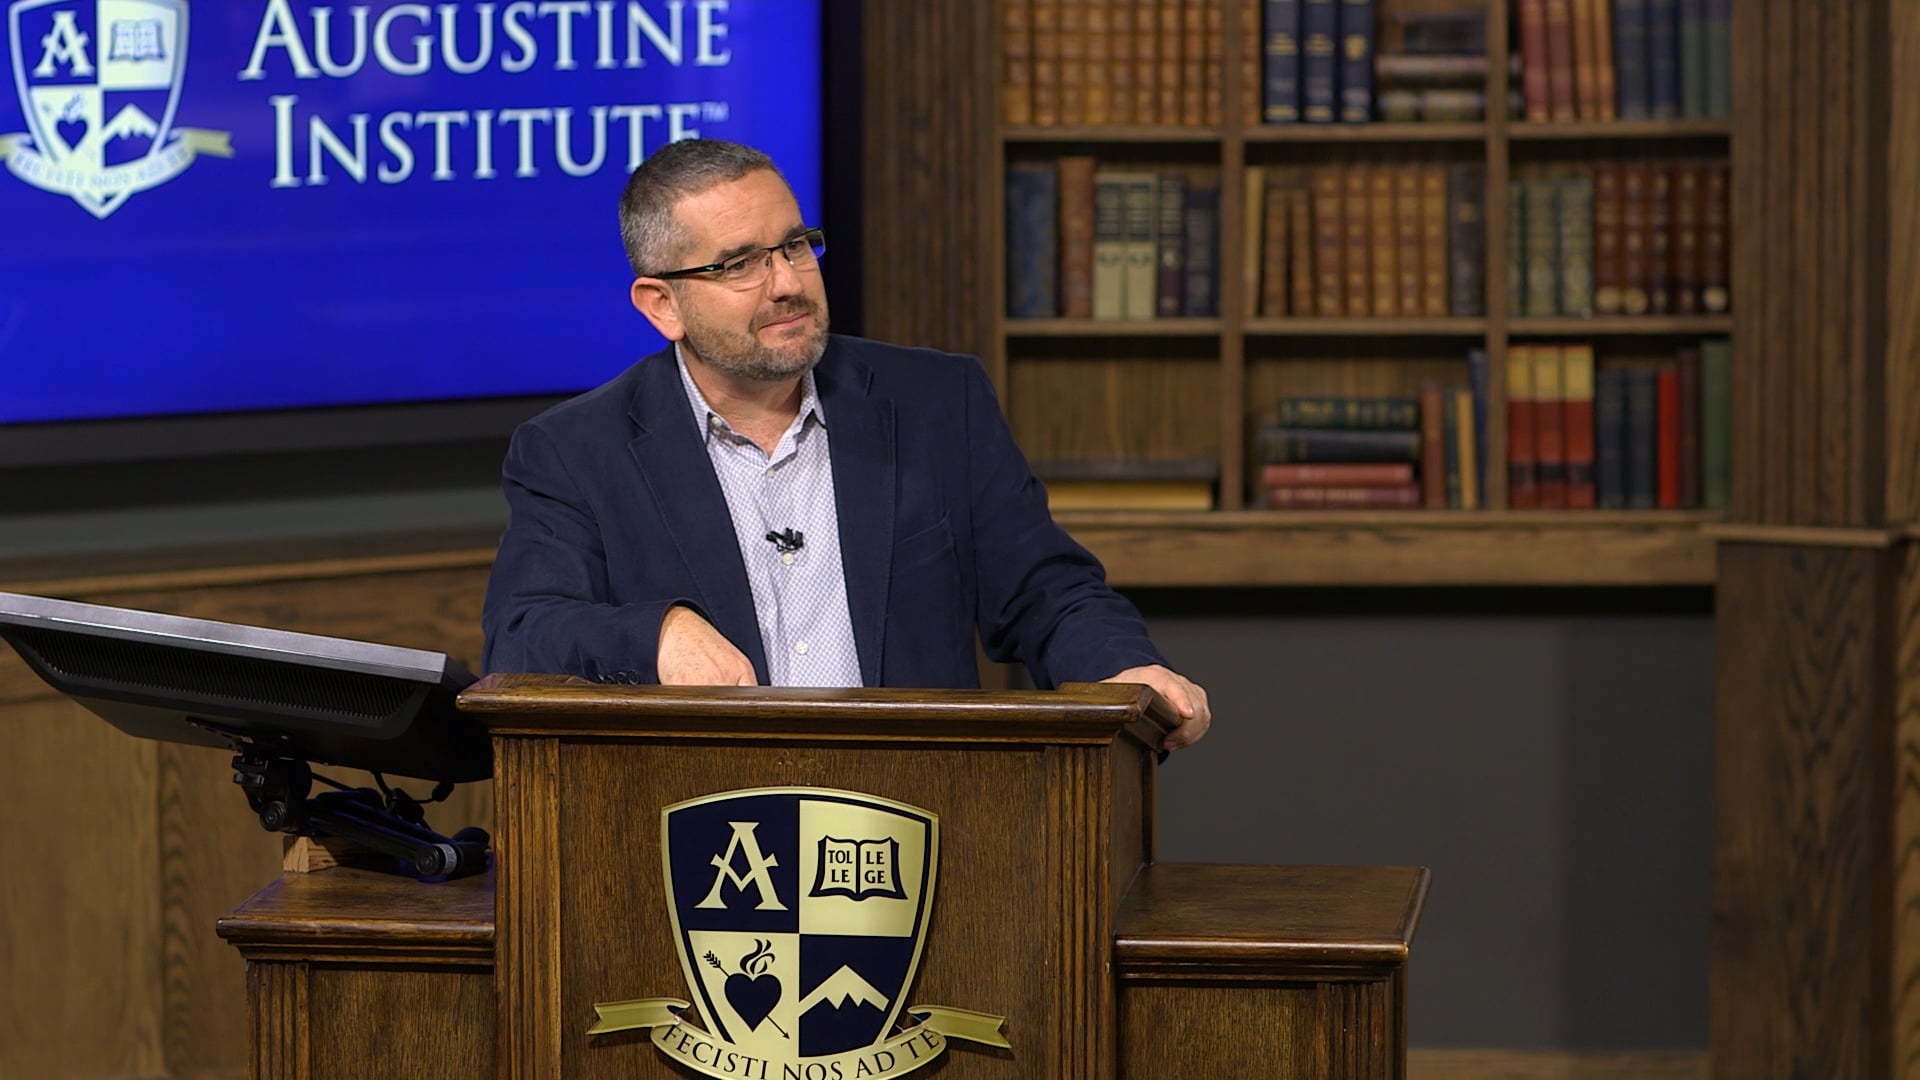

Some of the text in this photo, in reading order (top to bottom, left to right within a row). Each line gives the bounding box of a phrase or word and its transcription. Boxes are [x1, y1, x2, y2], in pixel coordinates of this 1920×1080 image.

[238, 0, 732, 80] AUGUSTINE
[827, 849, 853, 865] TOL
[865, 850, 885, 865] LE
[693, 821, 790, 911] A
[831, 868, 850, 883] LE
[864, 869, 886, 884] GE
[662, 1024, 941, 1080] FECISTI NOS AD TE
